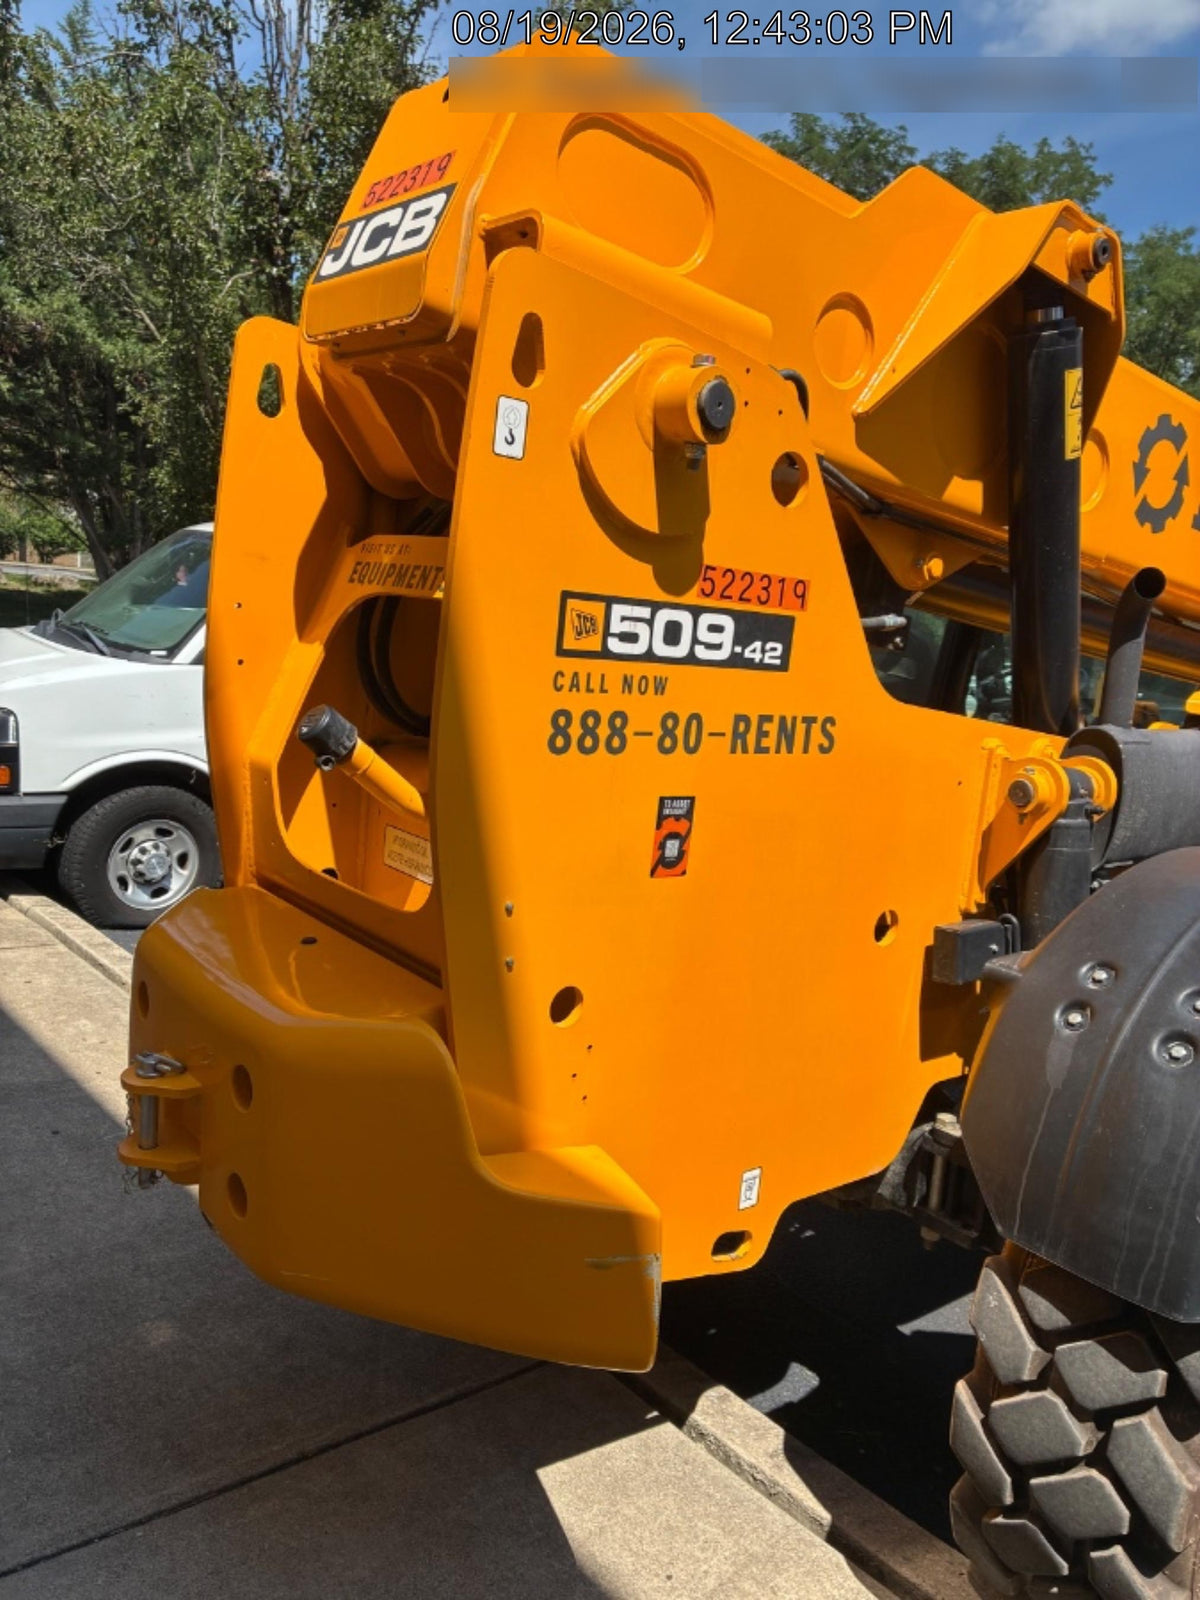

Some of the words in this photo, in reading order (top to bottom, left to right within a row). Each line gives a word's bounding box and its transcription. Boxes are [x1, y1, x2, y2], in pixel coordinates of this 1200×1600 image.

[363, 152, 453, 209] 522319
[319, 193, 447, 276] JCB
[700, 565, 808, 610] 522319
[572, 609, 599, 640] JCB
[553, 670, 609, 694] CALL
[622, 674, 669, 696] NOW
[547, 708, 837, 756] 888-80-RENTS
